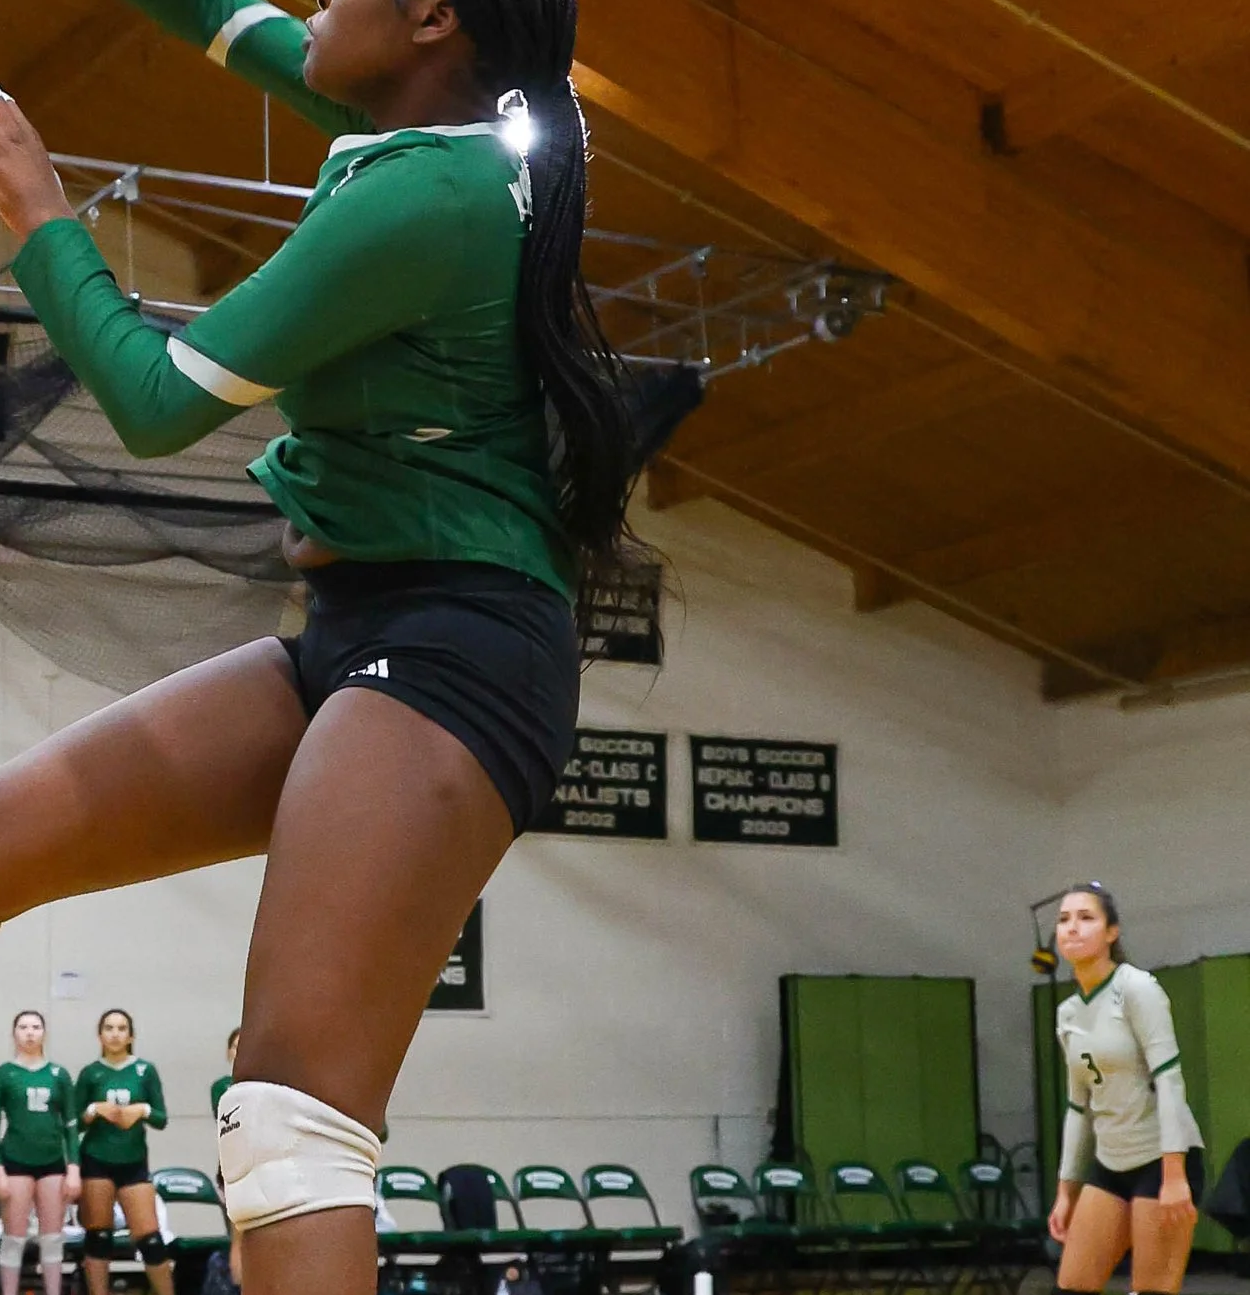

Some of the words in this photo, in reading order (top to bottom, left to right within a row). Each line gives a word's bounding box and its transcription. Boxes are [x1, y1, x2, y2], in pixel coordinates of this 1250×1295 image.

[579, 737, 654, 755] SOCCER
[702, 745, 749, 763] BOYS
[756, 748, 825, 765] SOCCER
[769, 771, 815, 790] CLASS
[551, 785, 650, 807] NALISTS
[705, 792, 824, 816] CHAMPIONS
[1080, 1052, 1103, 1085] 3
